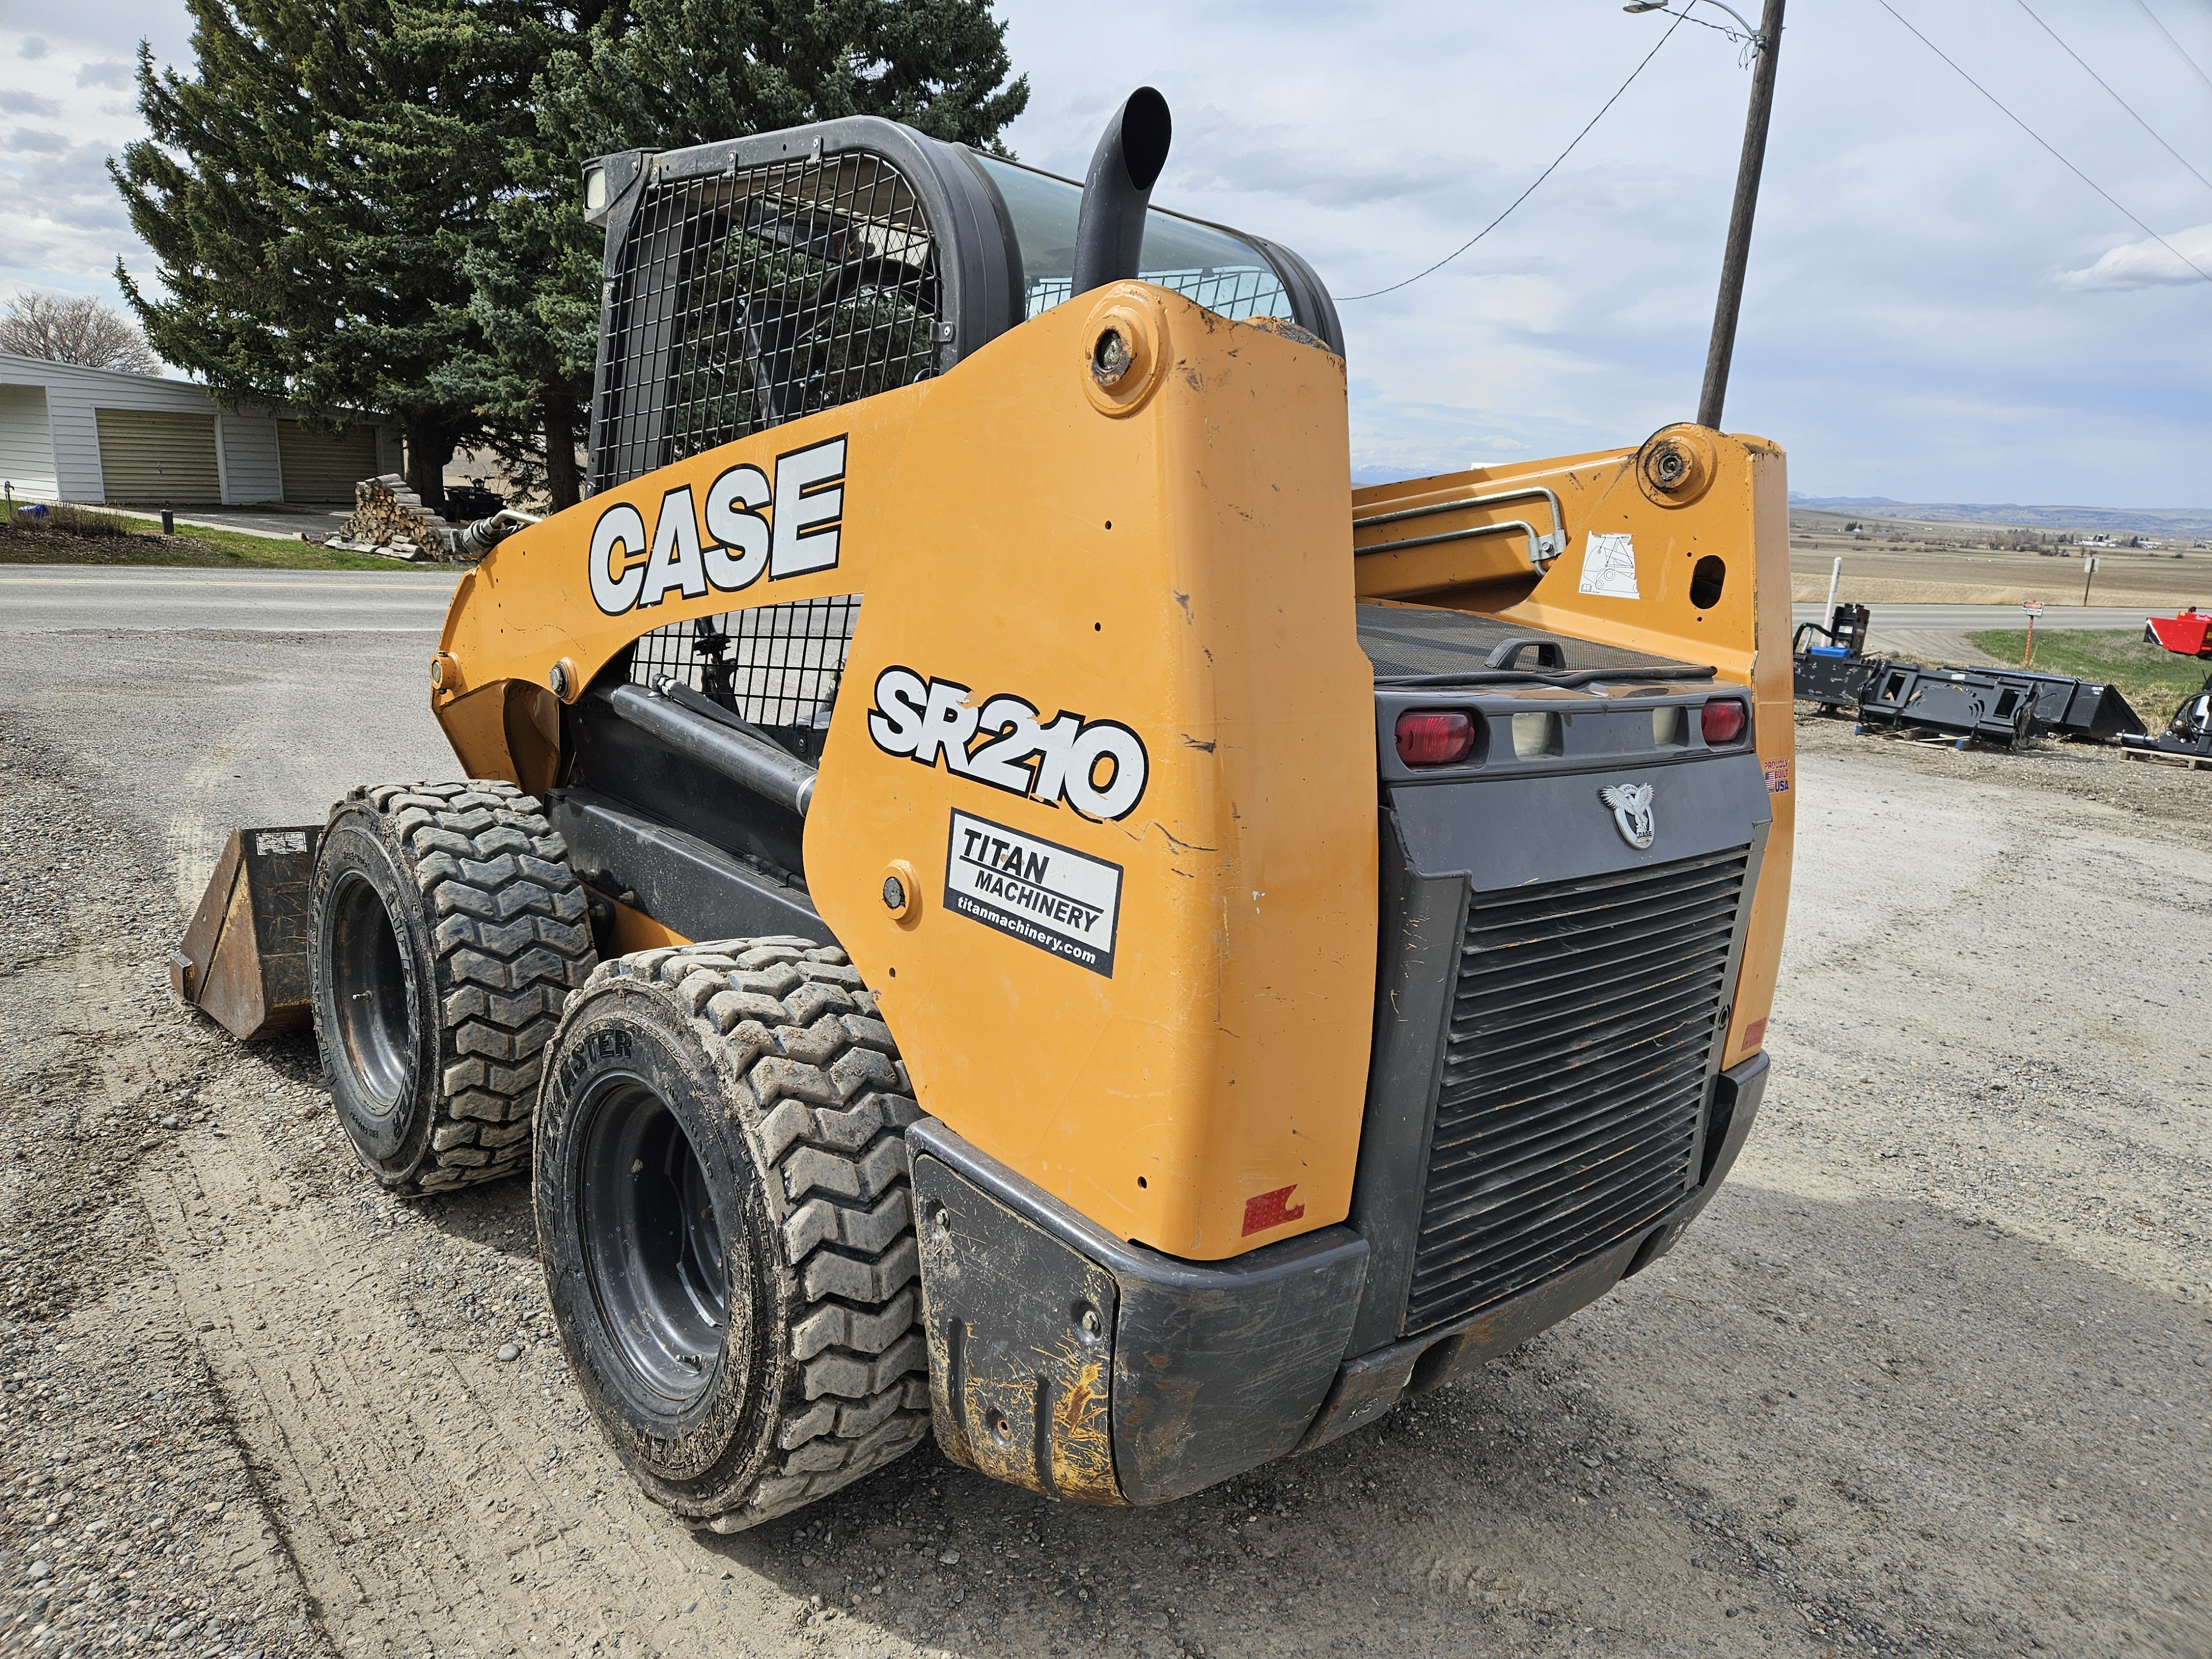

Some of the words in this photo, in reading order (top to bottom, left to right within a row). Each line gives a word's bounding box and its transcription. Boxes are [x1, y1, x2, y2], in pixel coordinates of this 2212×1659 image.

[589, 432, 848, 616] CASE
[867, 665, 1149, 823] SR210
[1765, 759, 1789, 769] PROUDLY
[1775, 770, 1788, 779] BUILT
[1775, 780, 1789, 792] USA
[963, 828, 1050, 885] TITAN
[957, 896, 1095, 964] titanmachinery.com
[974, 870, 1100, 933] MACHINERY
